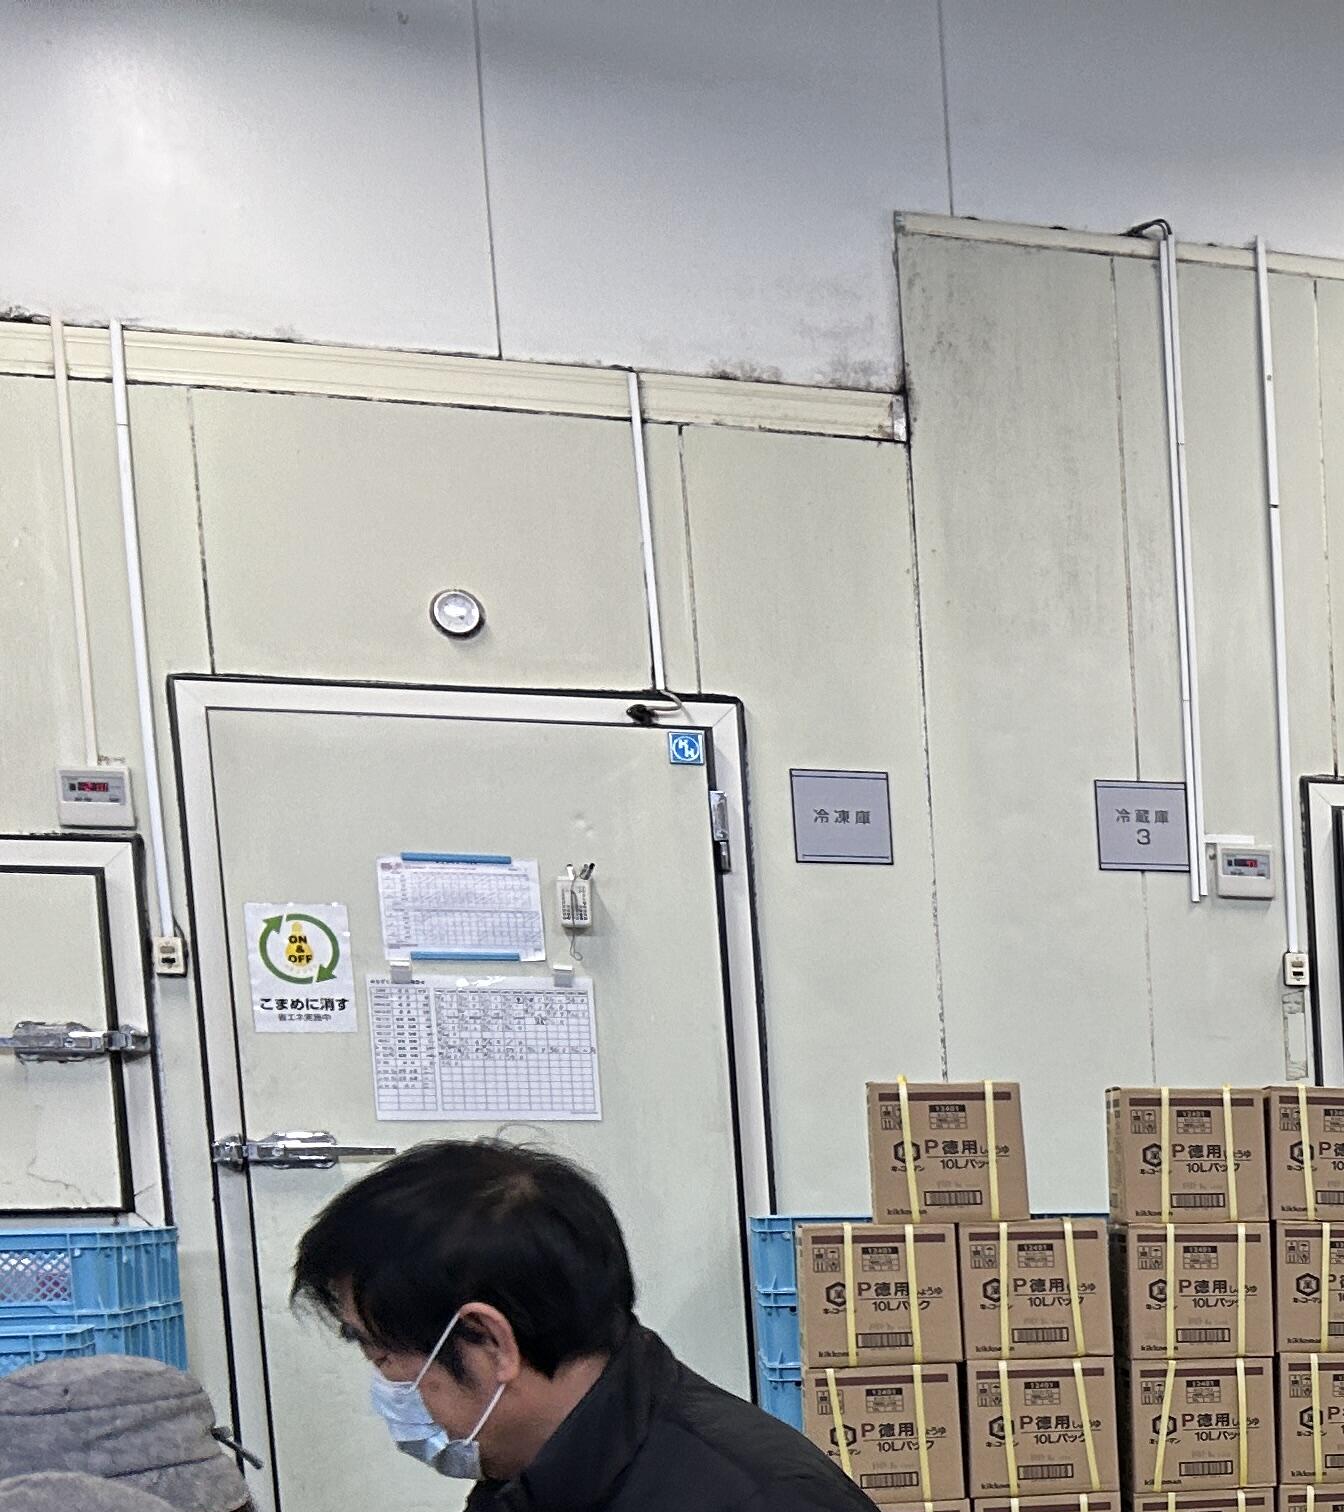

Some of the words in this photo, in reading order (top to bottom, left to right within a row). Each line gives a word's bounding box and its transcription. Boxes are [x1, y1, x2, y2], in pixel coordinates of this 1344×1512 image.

[813, 808, 871, 824] 冷凍庫
[1115, 808, 1169, 824] 冷蔵庫
[1136, 828, 1151, 845] 3
[288, 935, 307, 944] ON
[288, 954, 313, 964] OFF
[260, 998, 349, 1011] こまめに消す
